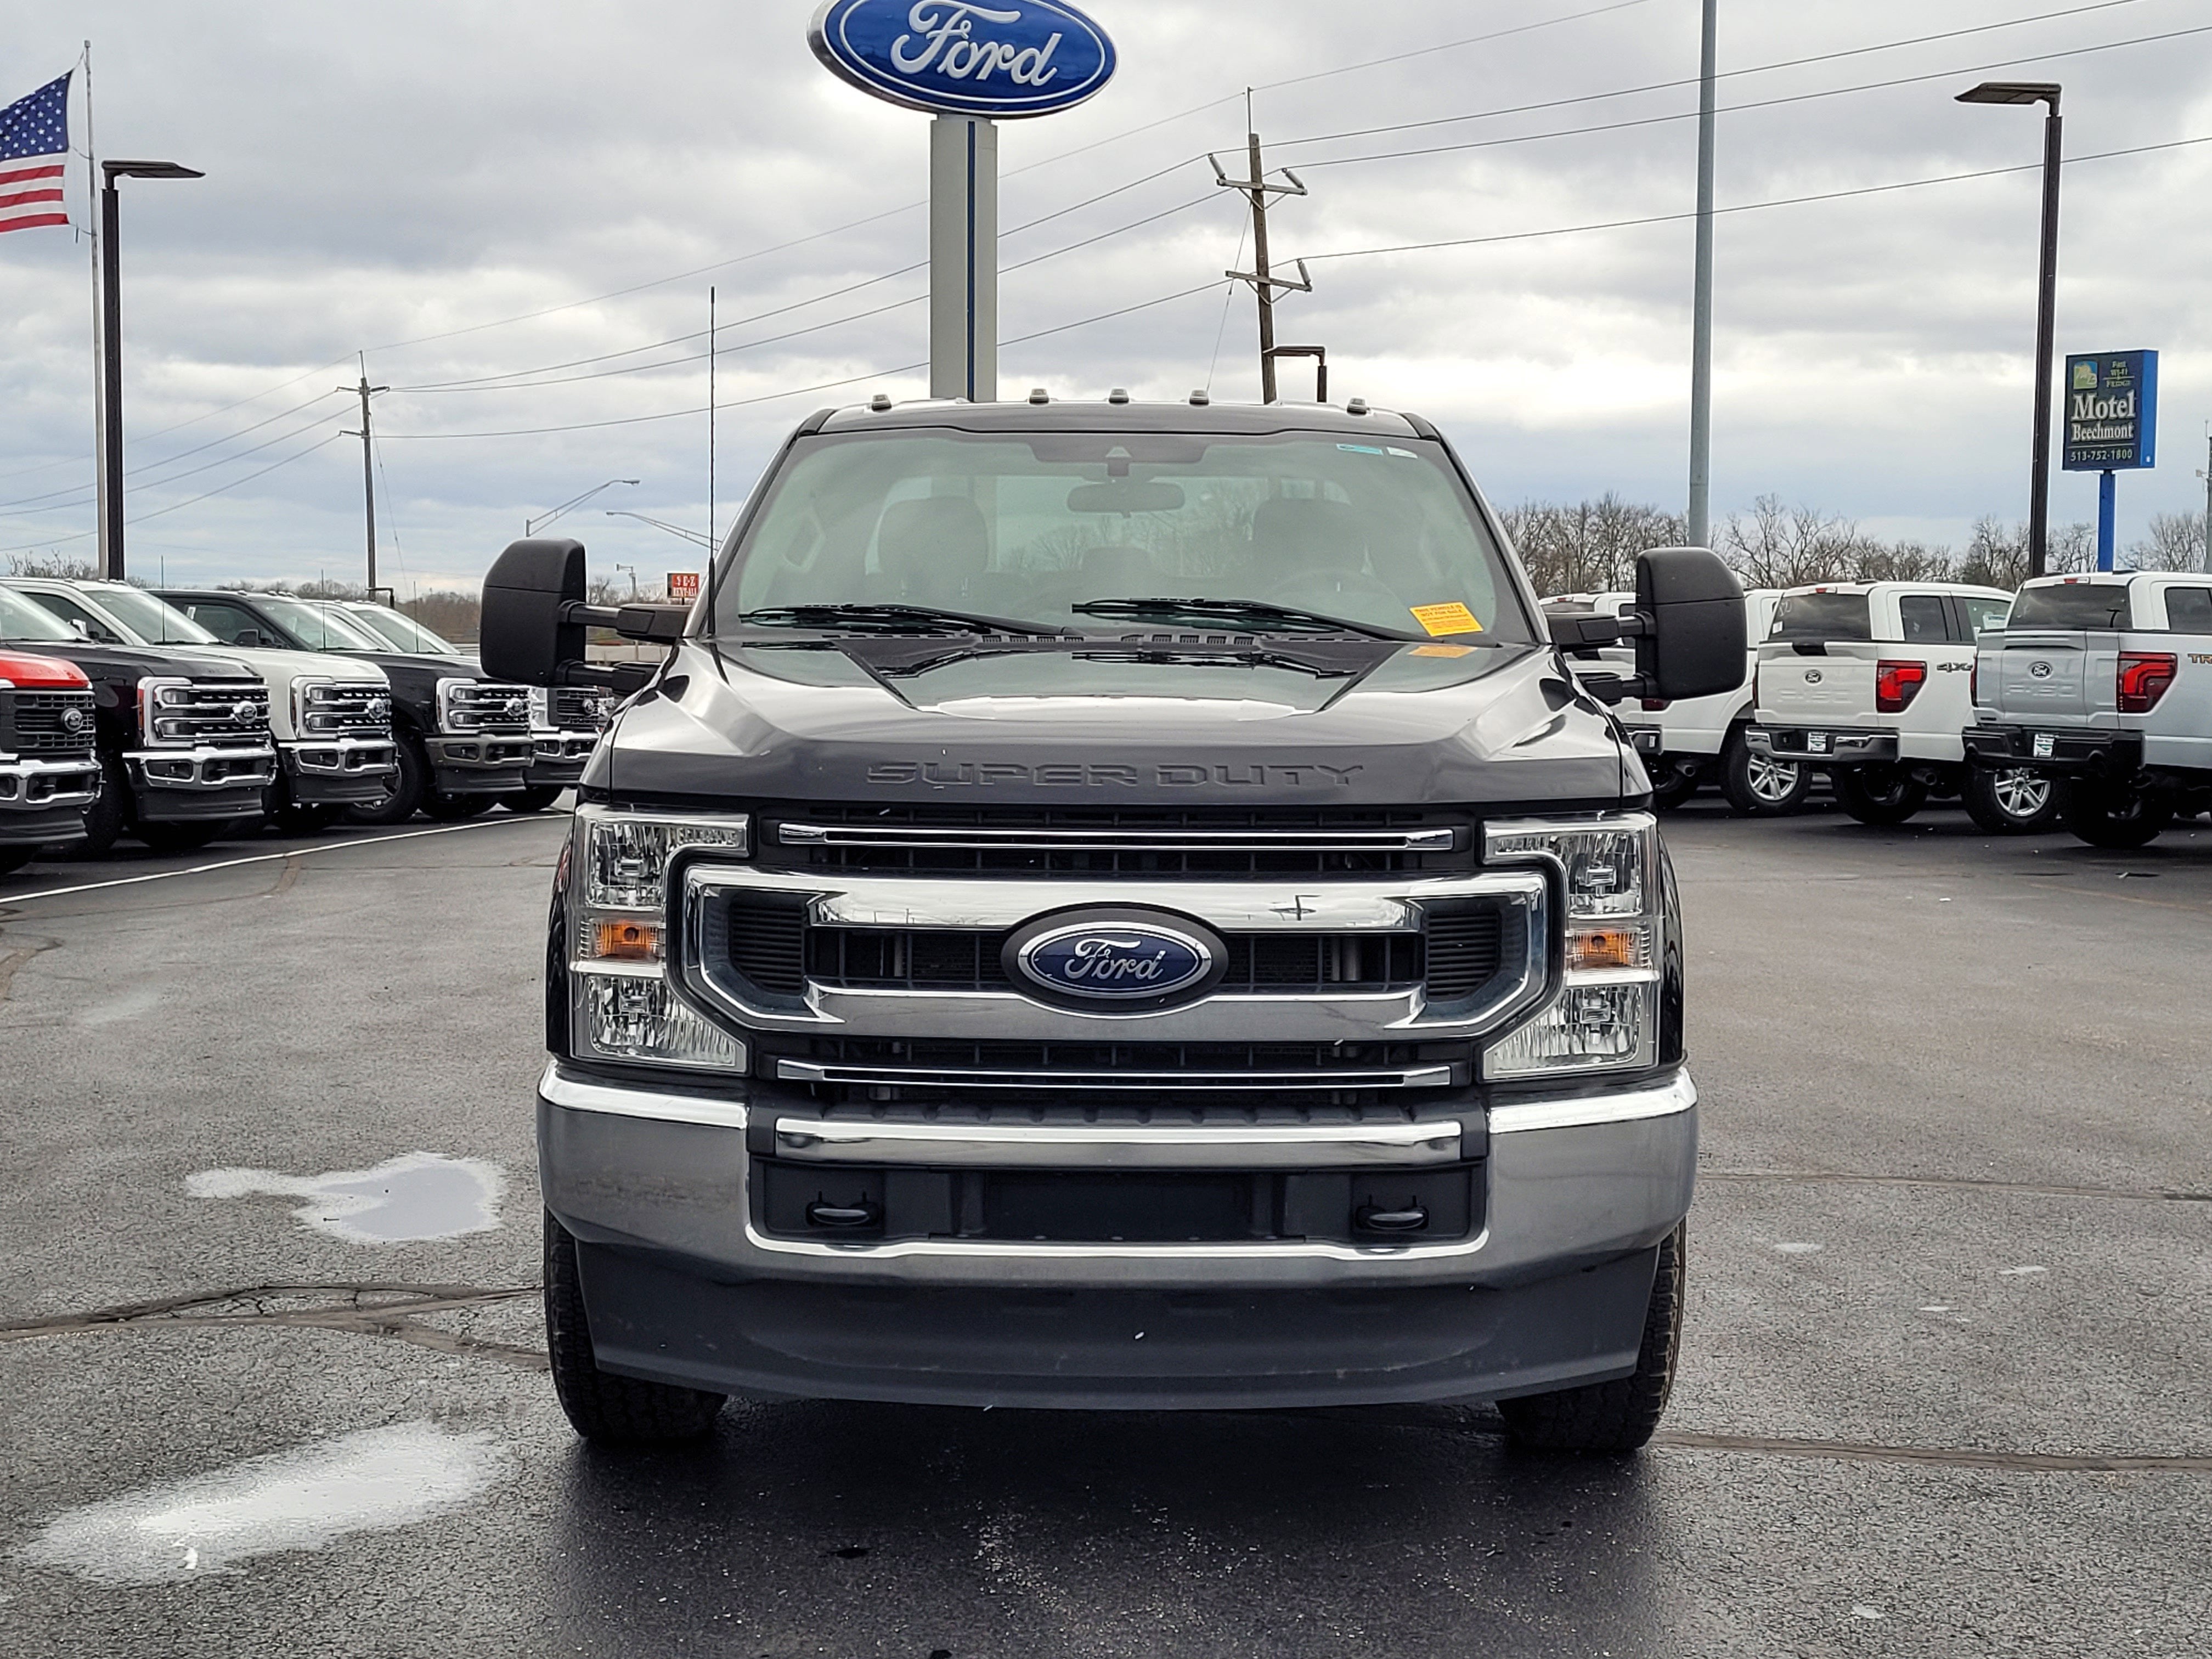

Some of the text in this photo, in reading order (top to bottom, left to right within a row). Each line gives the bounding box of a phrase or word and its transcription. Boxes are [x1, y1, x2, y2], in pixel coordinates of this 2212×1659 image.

[890, 0, 1063, 86] Ford
[2071, 390, 2136, 421] Motel
[2071, 421, 2134, 442] Beechmont
[866, 762, 1363, 786] SUPER DUTY
[1064, 938, 1166, 980] Ford
